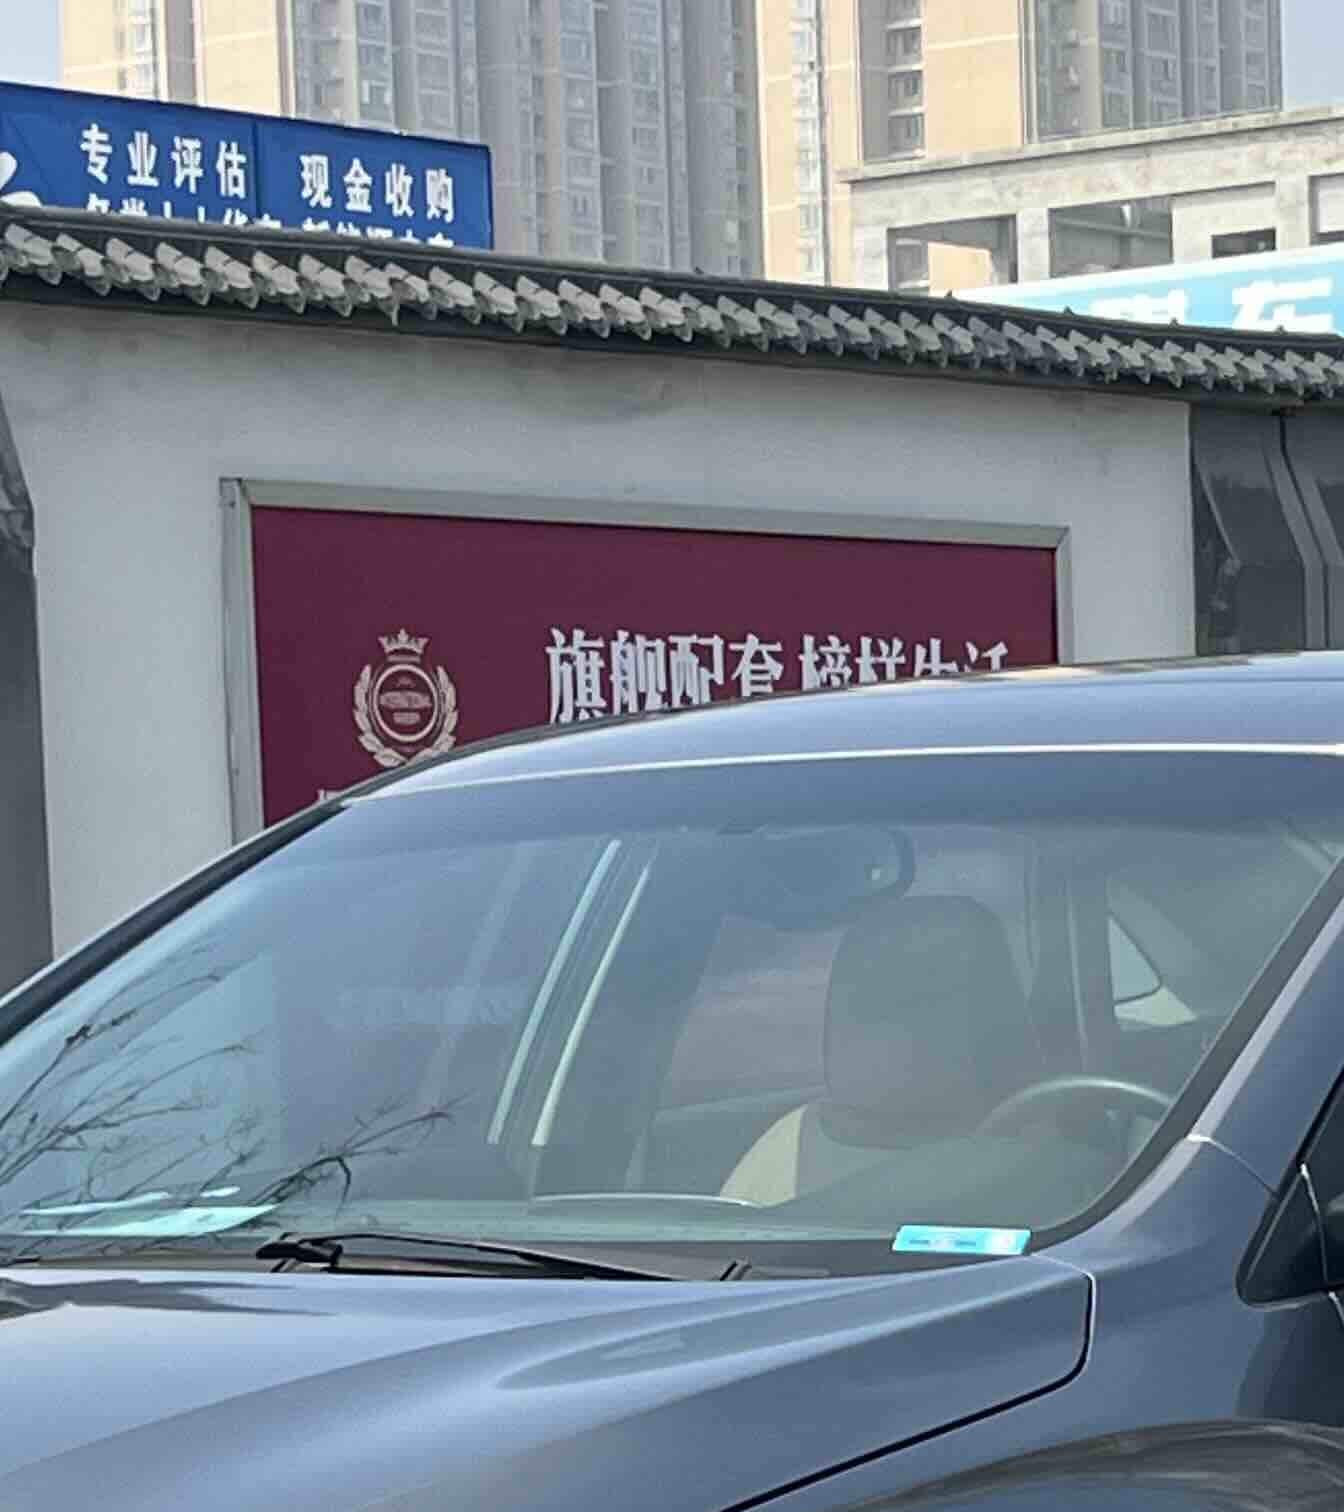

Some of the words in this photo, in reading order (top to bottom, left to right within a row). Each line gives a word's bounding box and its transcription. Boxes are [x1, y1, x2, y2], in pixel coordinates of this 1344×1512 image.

[80, 123, 247, 199] 专业评估
[299, 155, 454, 223] 现金收购
[546, 628, 784, 724] 旗舰配套
